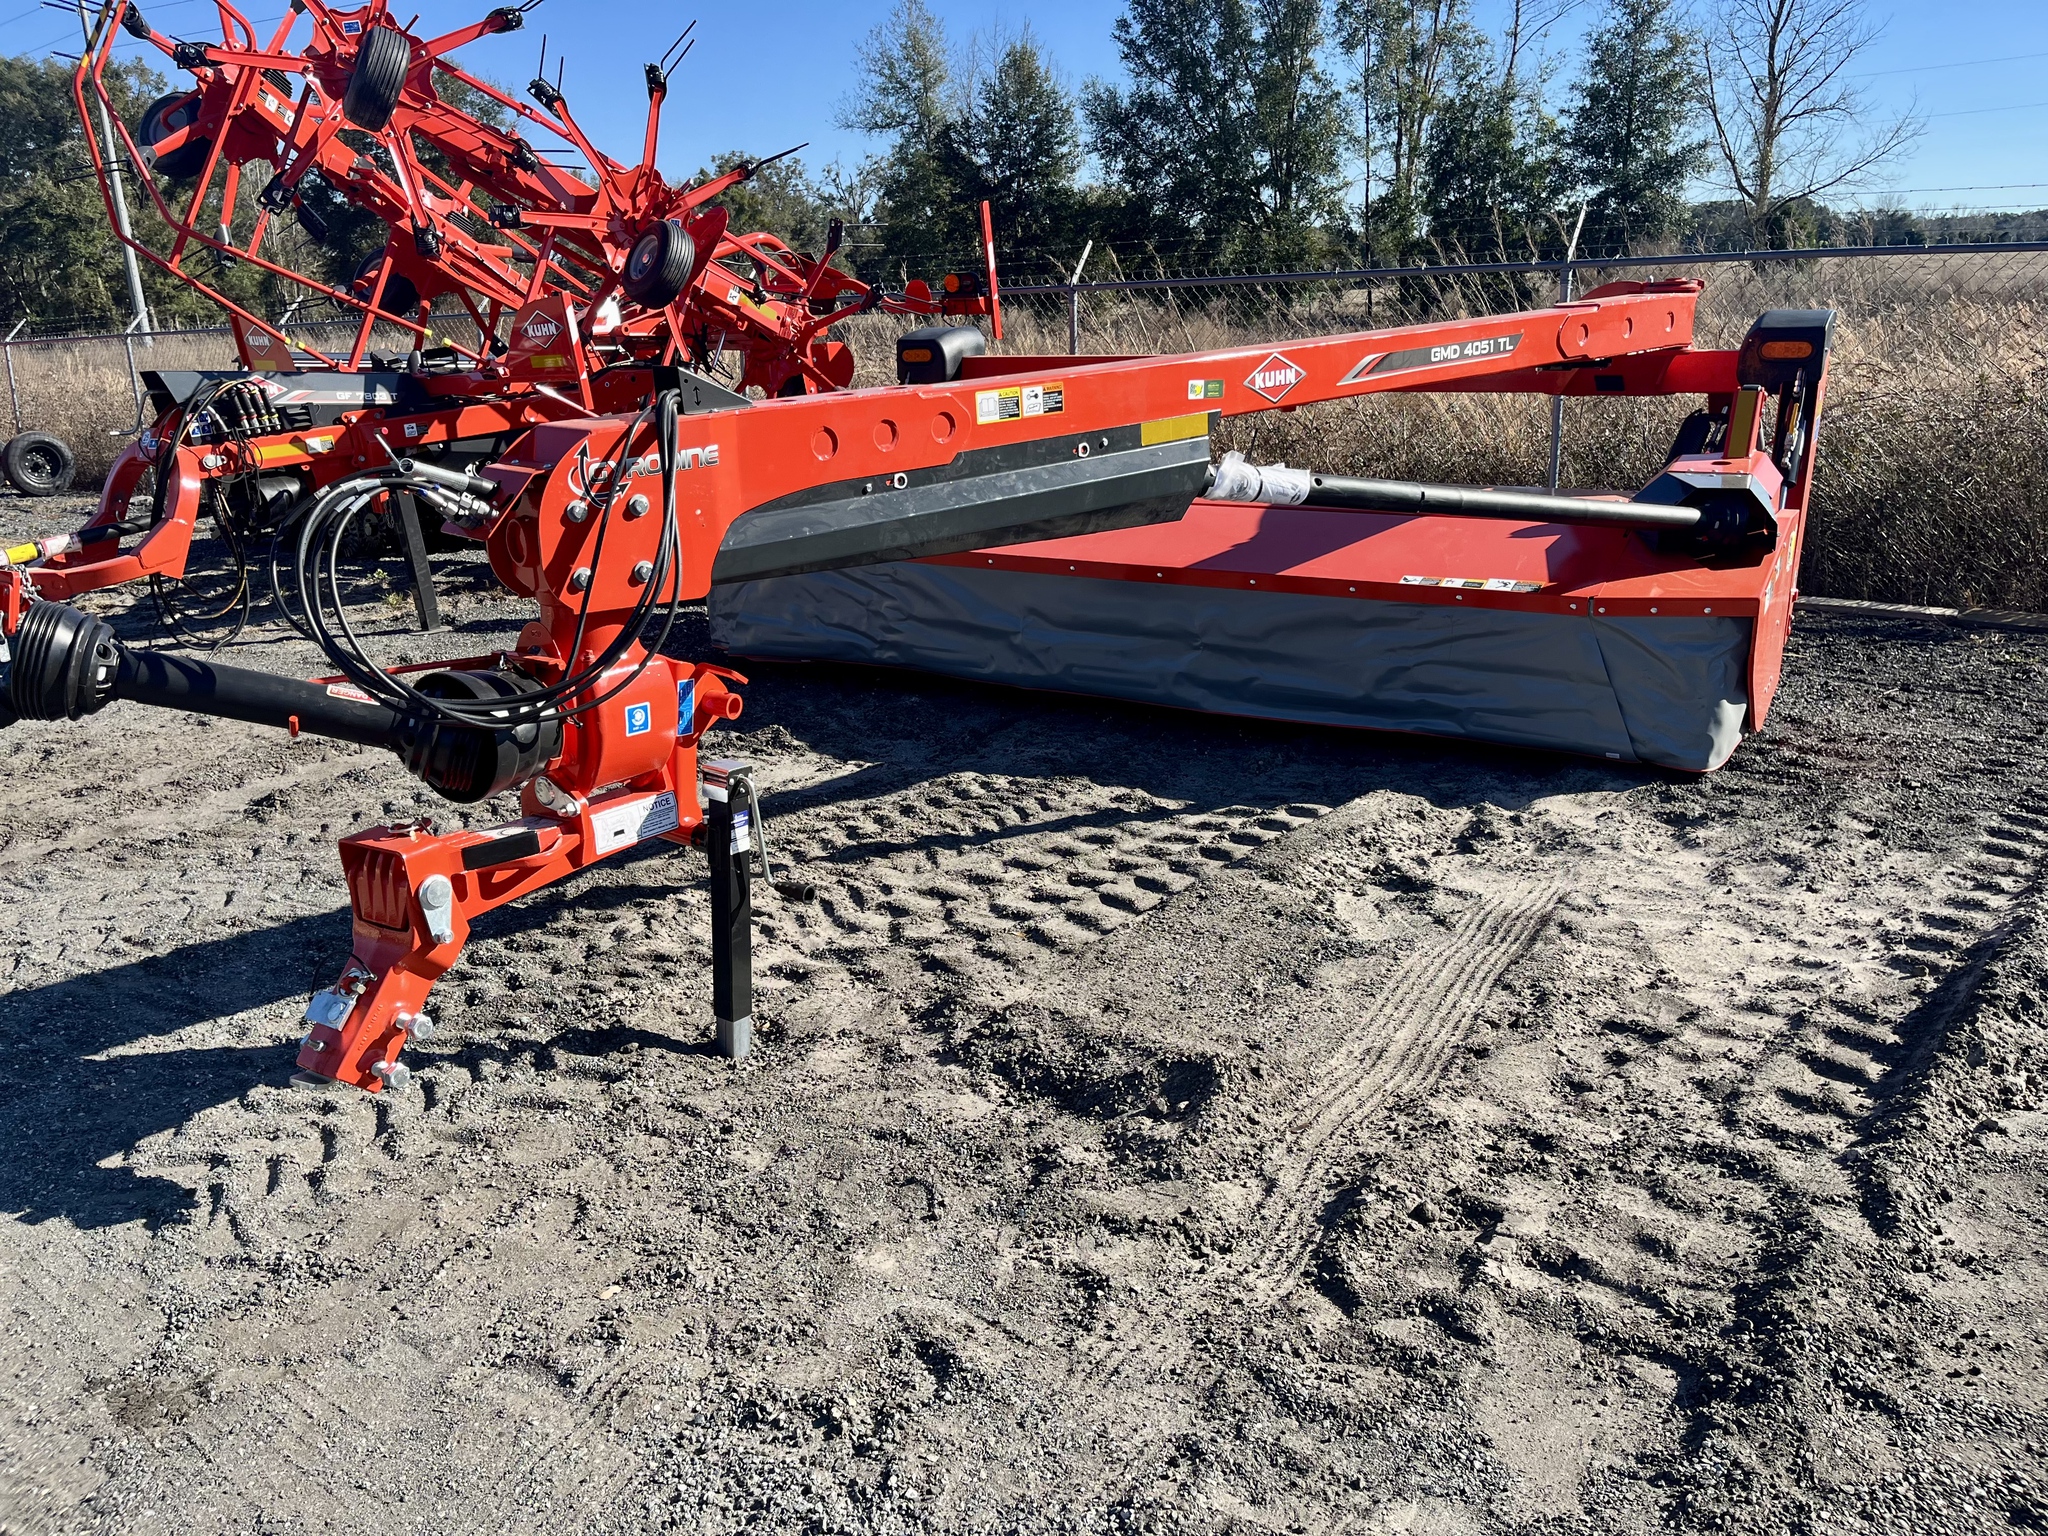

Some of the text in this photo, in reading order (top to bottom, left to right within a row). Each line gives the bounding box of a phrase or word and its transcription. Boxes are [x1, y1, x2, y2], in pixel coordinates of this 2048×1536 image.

[527, 322, 557, 337] KUHN
[248, 335, 270, 347] KUHN
[1431, 336, 1514, 362] GMD 4051 TL
[1254, 367, 1297, 390] KUHN
[336, 391, 398, 401] GF 7803 T
[330, 687, 369, 700] DANGER
[642, 797, 672, 812] NOTICE
